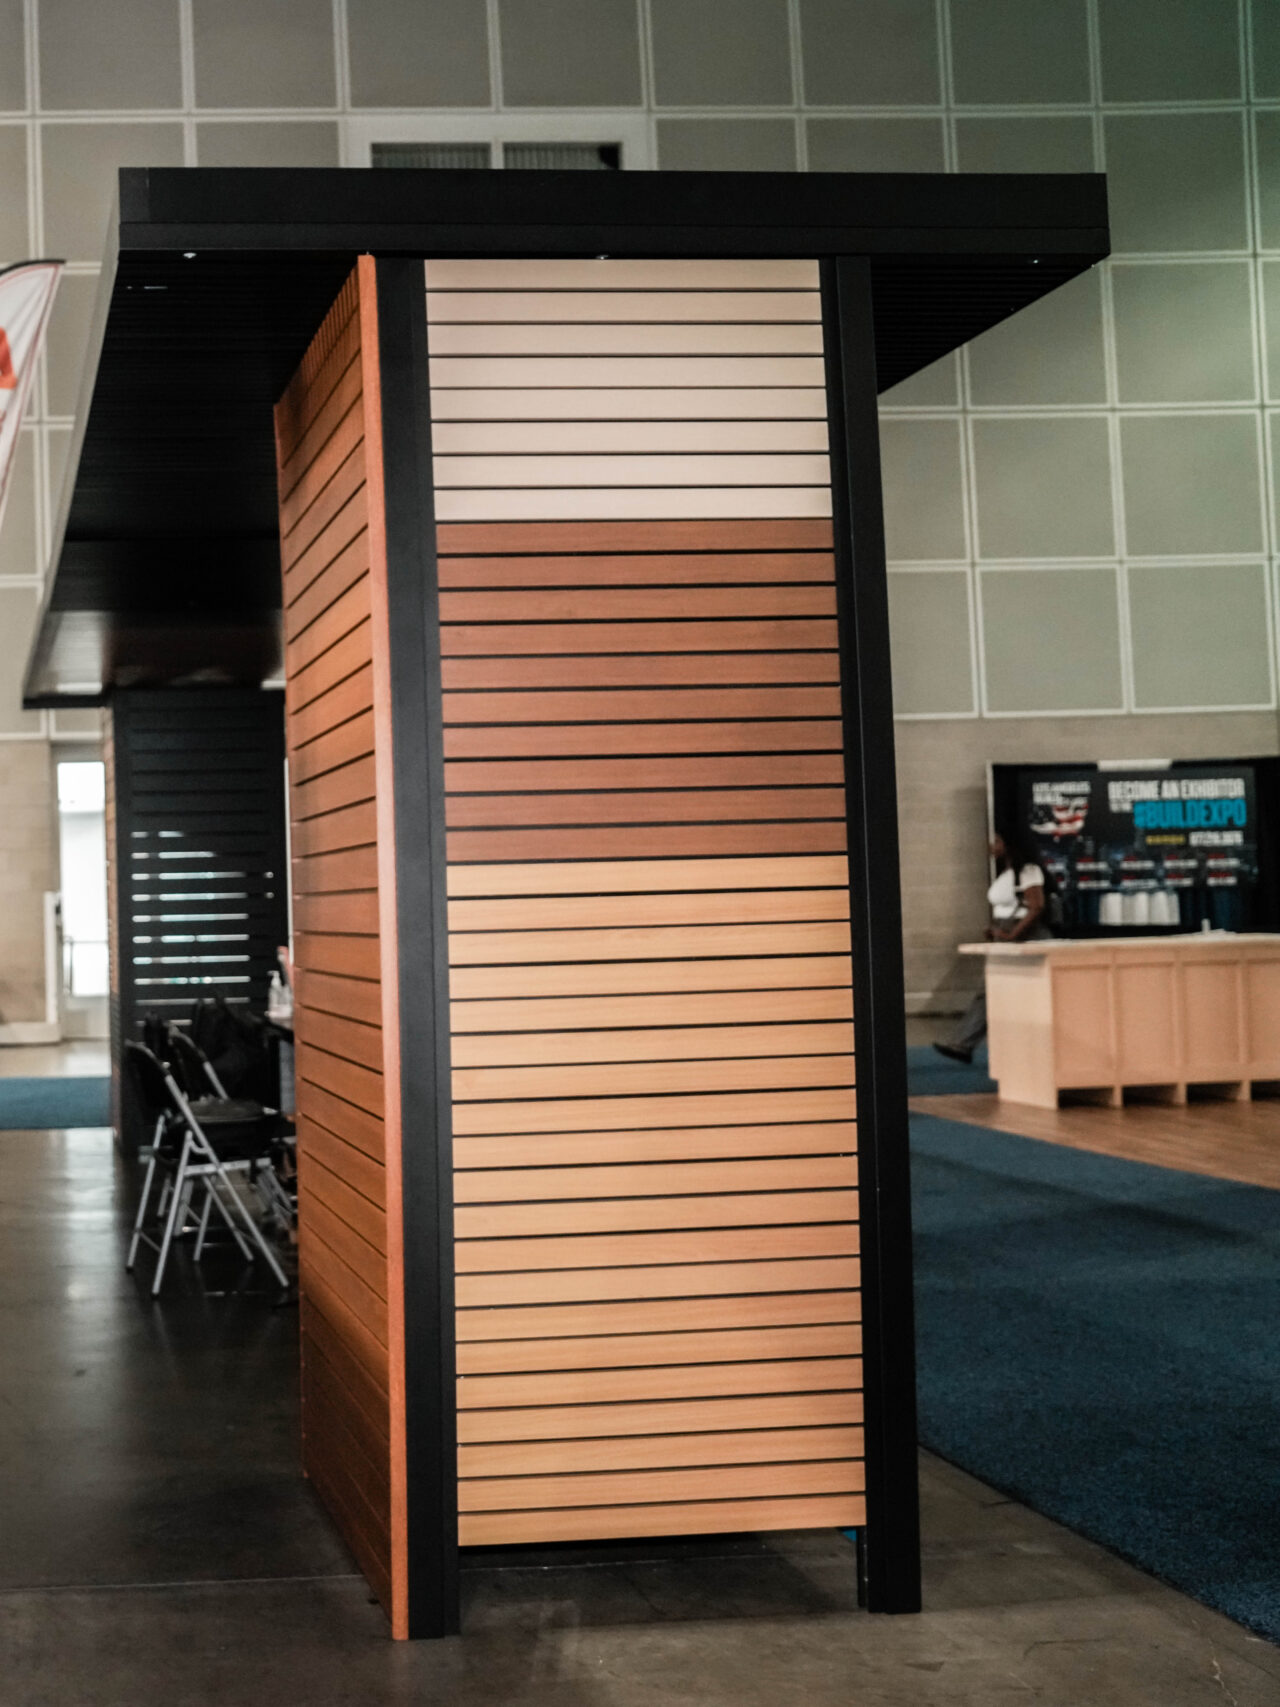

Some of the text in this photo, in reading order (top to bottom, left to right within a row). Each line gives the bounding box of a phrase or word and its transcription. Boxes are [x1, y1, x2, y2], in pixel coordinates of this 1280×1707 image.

[1108, 778, 1245, 801] BECOME AN EXHIBITOR
[1133, 799, 1247, 828] #BUILDEXPO
